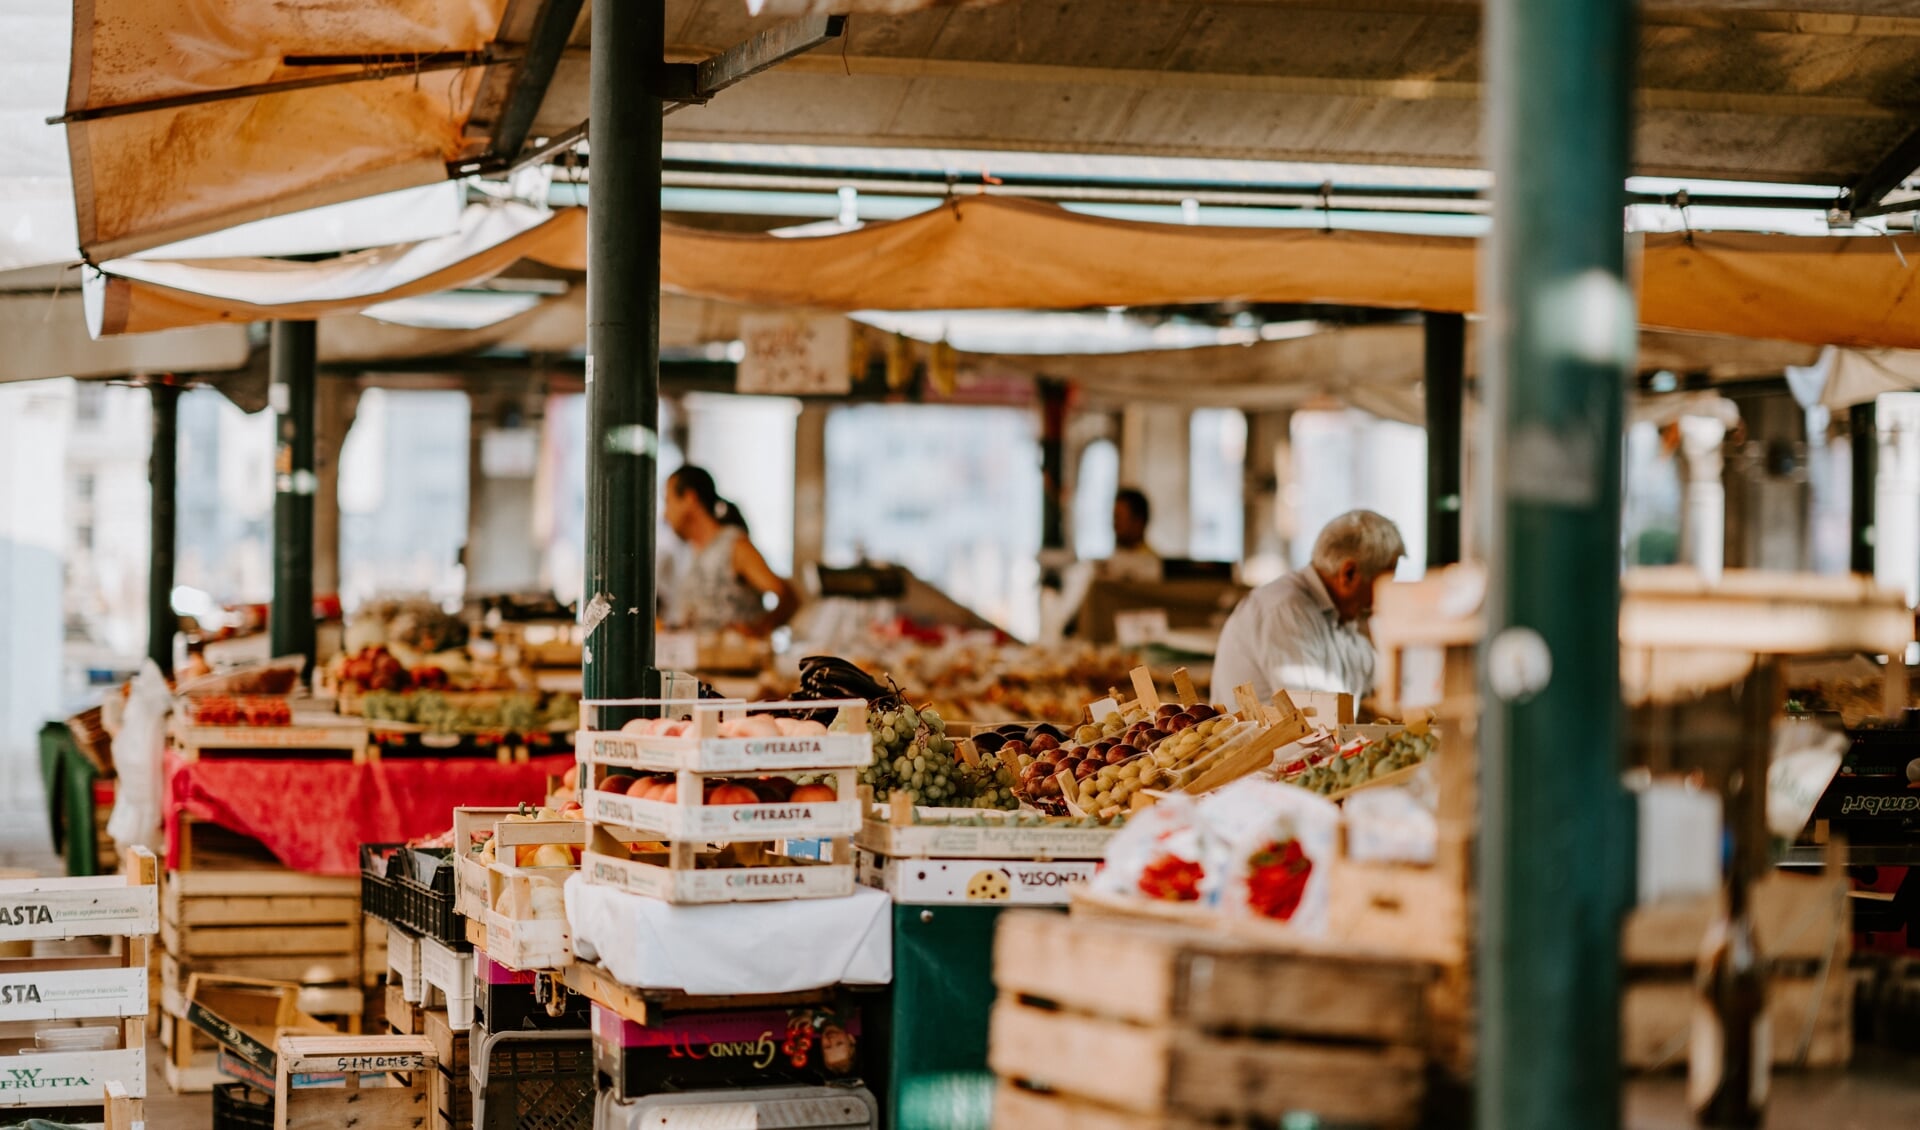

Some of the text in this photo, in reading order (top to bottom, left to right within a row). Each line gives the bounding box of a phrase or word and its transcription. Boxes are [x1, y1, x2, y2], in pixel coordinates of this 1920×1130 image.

[744, 741, 822, 755] COFERASTA
[1841, 795, 1920, 815] embri
[733, 808, 812, 821] COFERASTA
[725, 873, 804, 887] COFERASTA
[0, 984, 42, 1004] STA
[0, 1076, 90, 1089] FRUTTA
